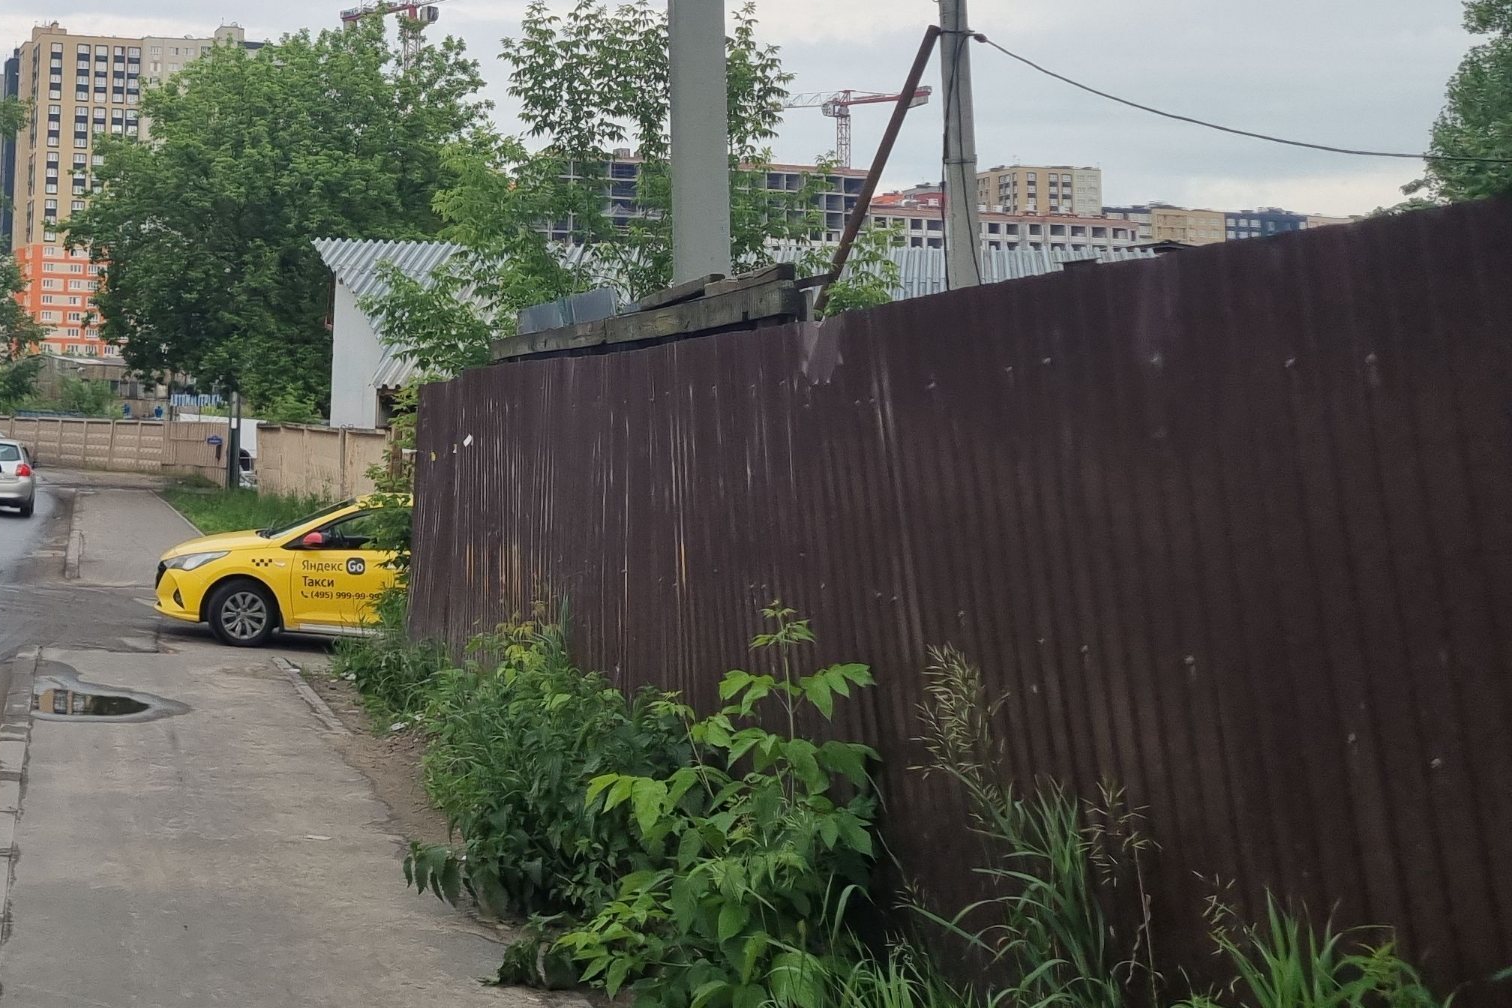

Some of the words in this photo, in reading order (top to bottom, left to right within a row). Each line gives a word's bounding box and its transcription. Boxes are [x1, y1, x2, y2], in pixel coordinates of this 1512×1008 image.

[302, 560, 343, 572] Яндекс
[348, 560, 364, 572] Go
[302, 576, 334, 587] Такси
[310, 591, 333, 599] (495)
